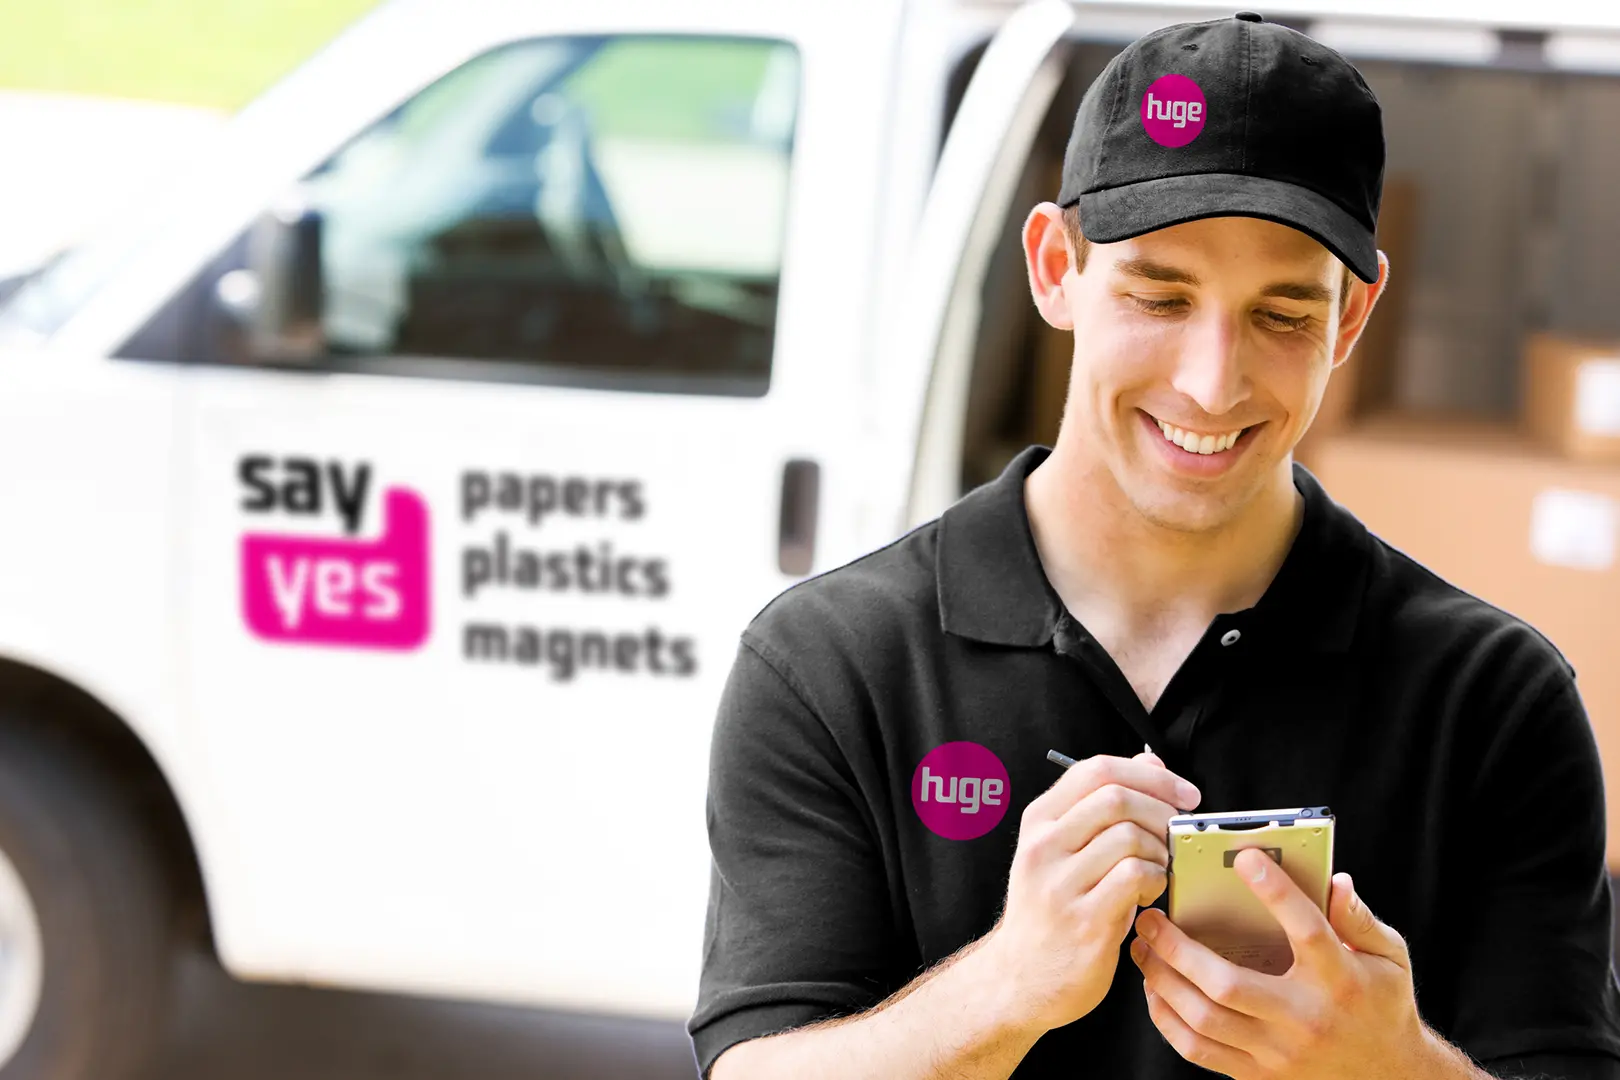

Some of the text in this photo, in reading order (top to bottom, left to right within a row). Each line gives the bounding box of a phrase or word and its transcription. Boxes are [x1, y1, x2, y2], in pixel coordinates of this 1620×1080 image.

[1147, 93, 1202, 128] huge
[237, 454, 372, 536] say
[460, 469, 645, 527] papers
[265, 554, 404, 630] yes
[460, 530, 671, 598] plastics
[460, 622, 699, 684] magnets
[921, 766, 1004, 814] huge
